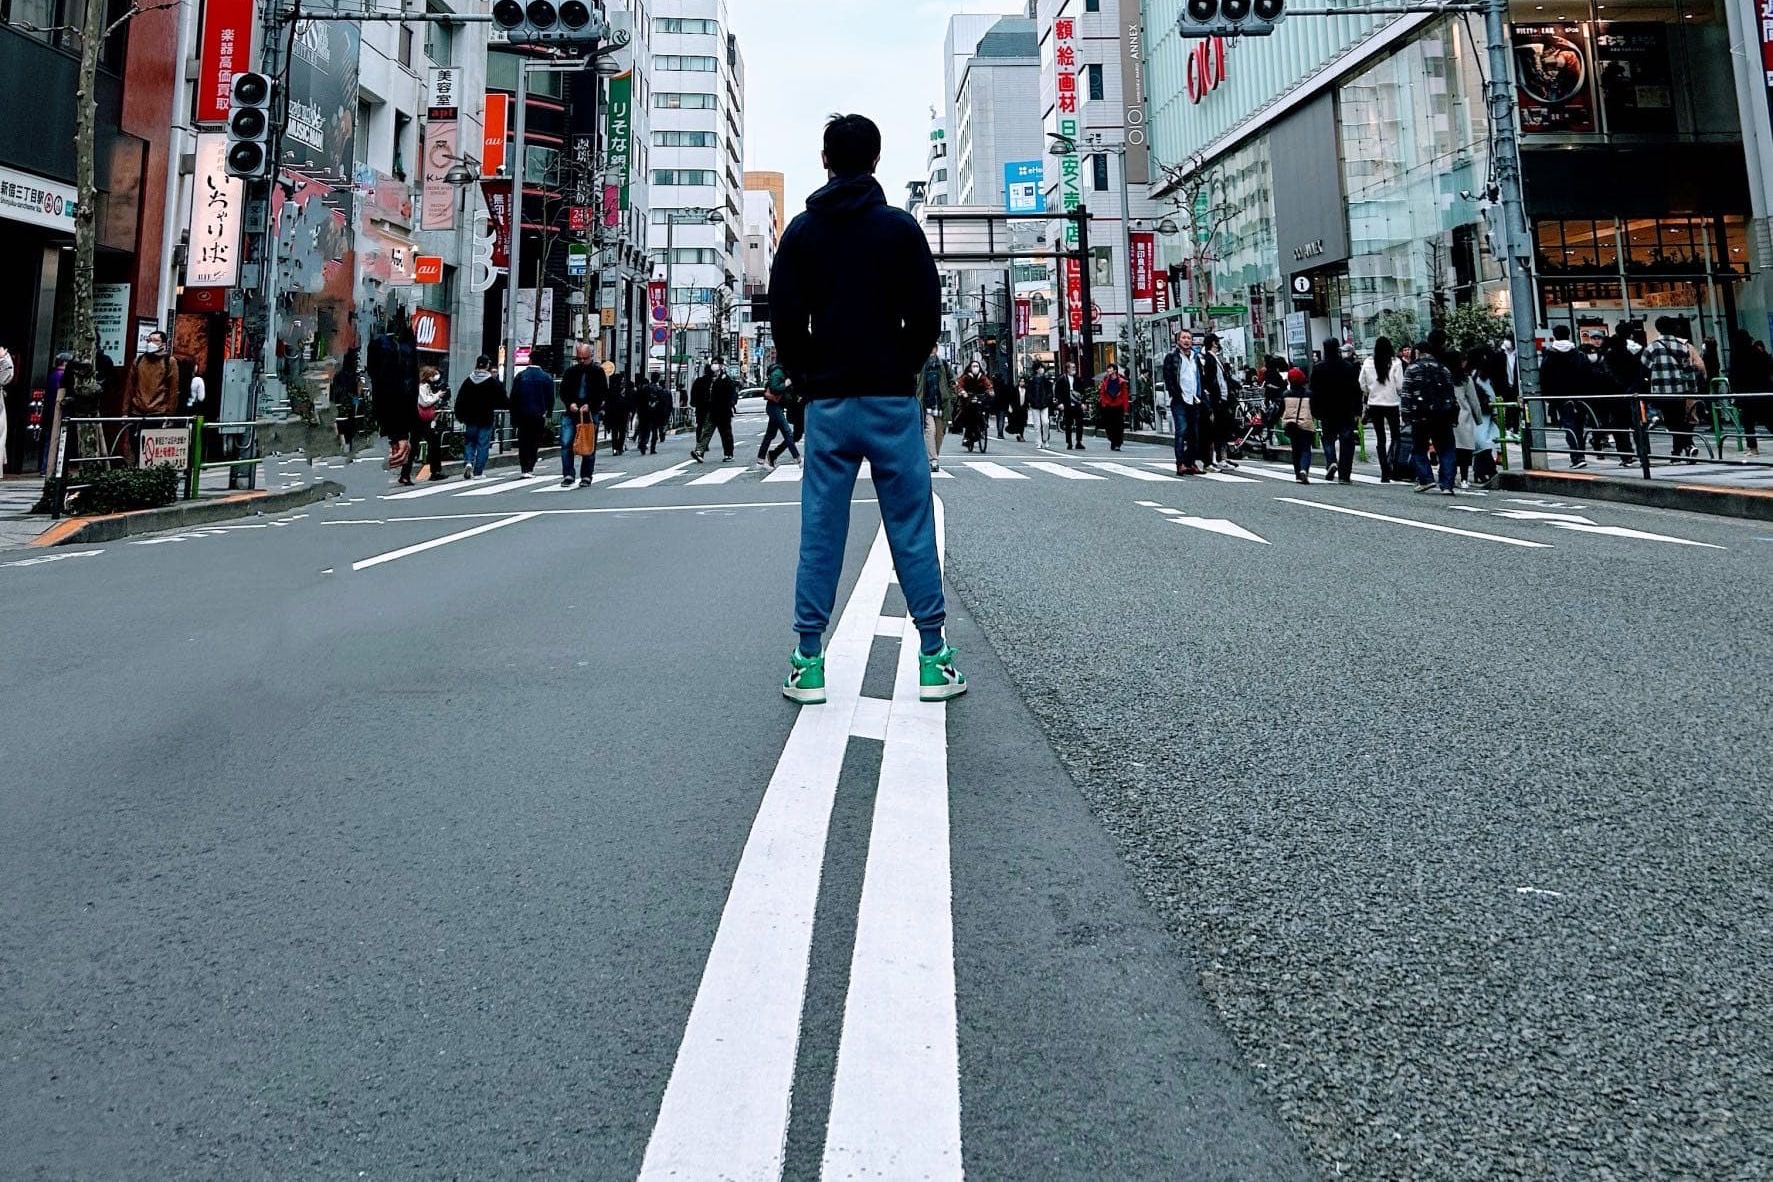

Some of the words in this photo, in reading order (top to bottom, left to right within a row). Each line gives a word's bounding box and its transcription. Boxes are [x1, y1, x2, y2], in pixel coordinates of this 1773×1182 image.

[1129, 24, 1138, 60] ANNEX
[215, 28, 235, 111] 楽器高価買取
[436, 70, 452, 106] 美容室
[485, 136, 503, 146] au
[0, 180, 45, 206] 新宿三丁目駅
[202, 174, 229, 264] いちゃりば
[417, 265, 438, 274] au
